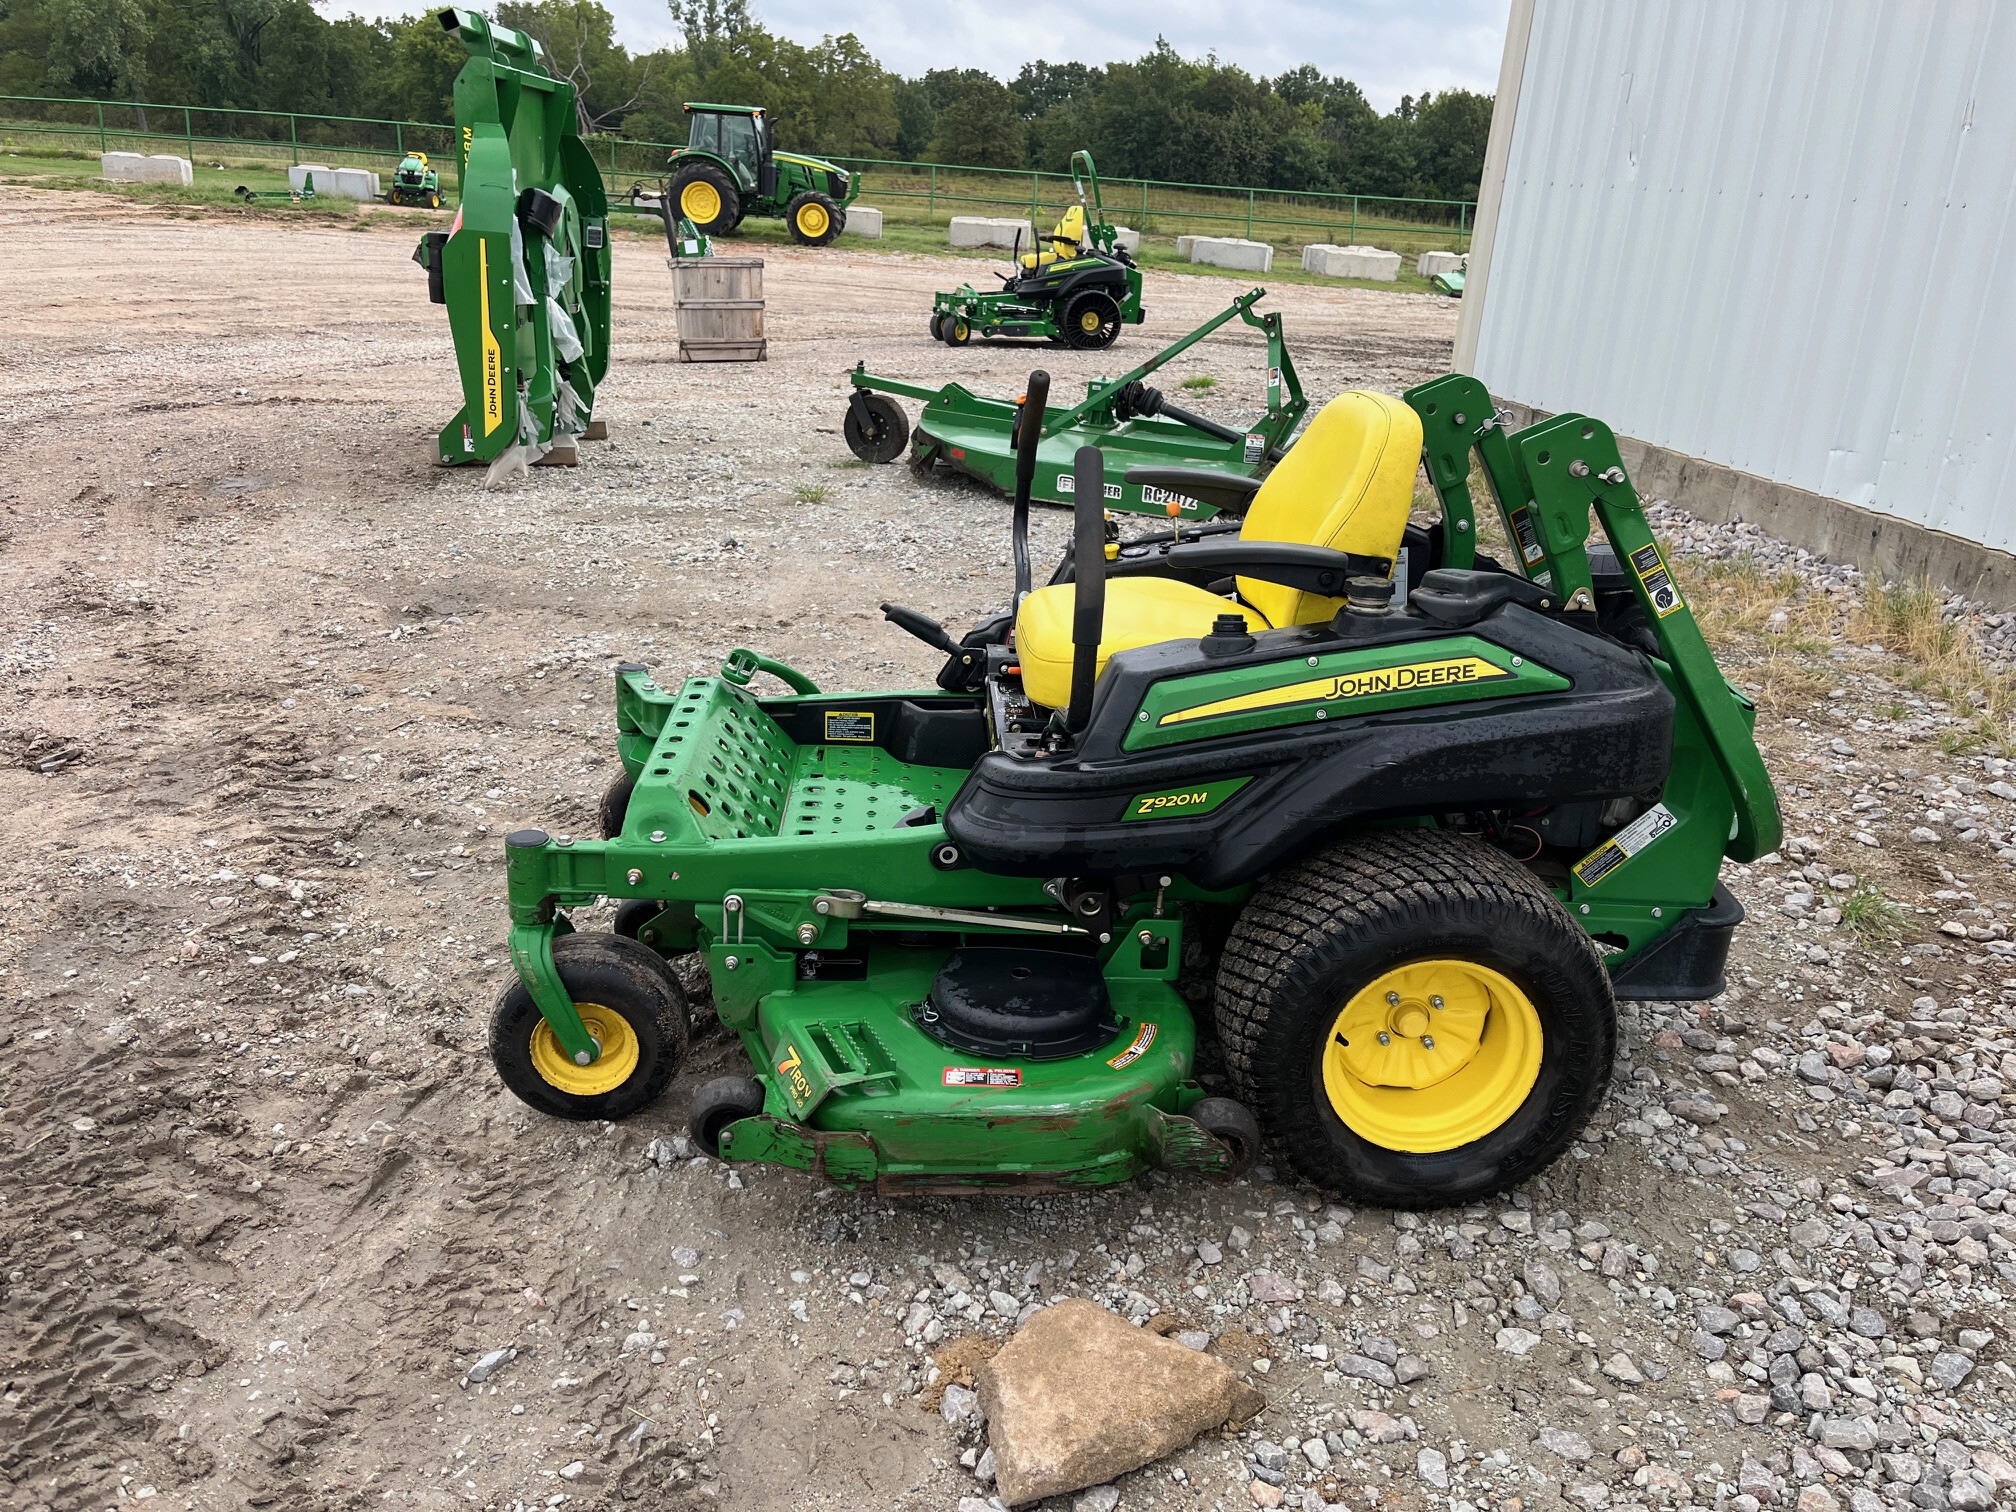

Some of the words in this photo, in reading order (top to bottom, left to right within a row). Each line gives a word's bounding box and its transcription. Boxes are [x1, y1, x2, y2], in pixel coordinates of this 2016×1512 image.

[487, 348, 496, 386] DEERE
[488, 388, 497, 418] JOHN
[1325, 674, 1391, 698] JOHN
[1397, 663, 1477, 687] DEERE
[1137, 792, 1208, 814] Z920M
